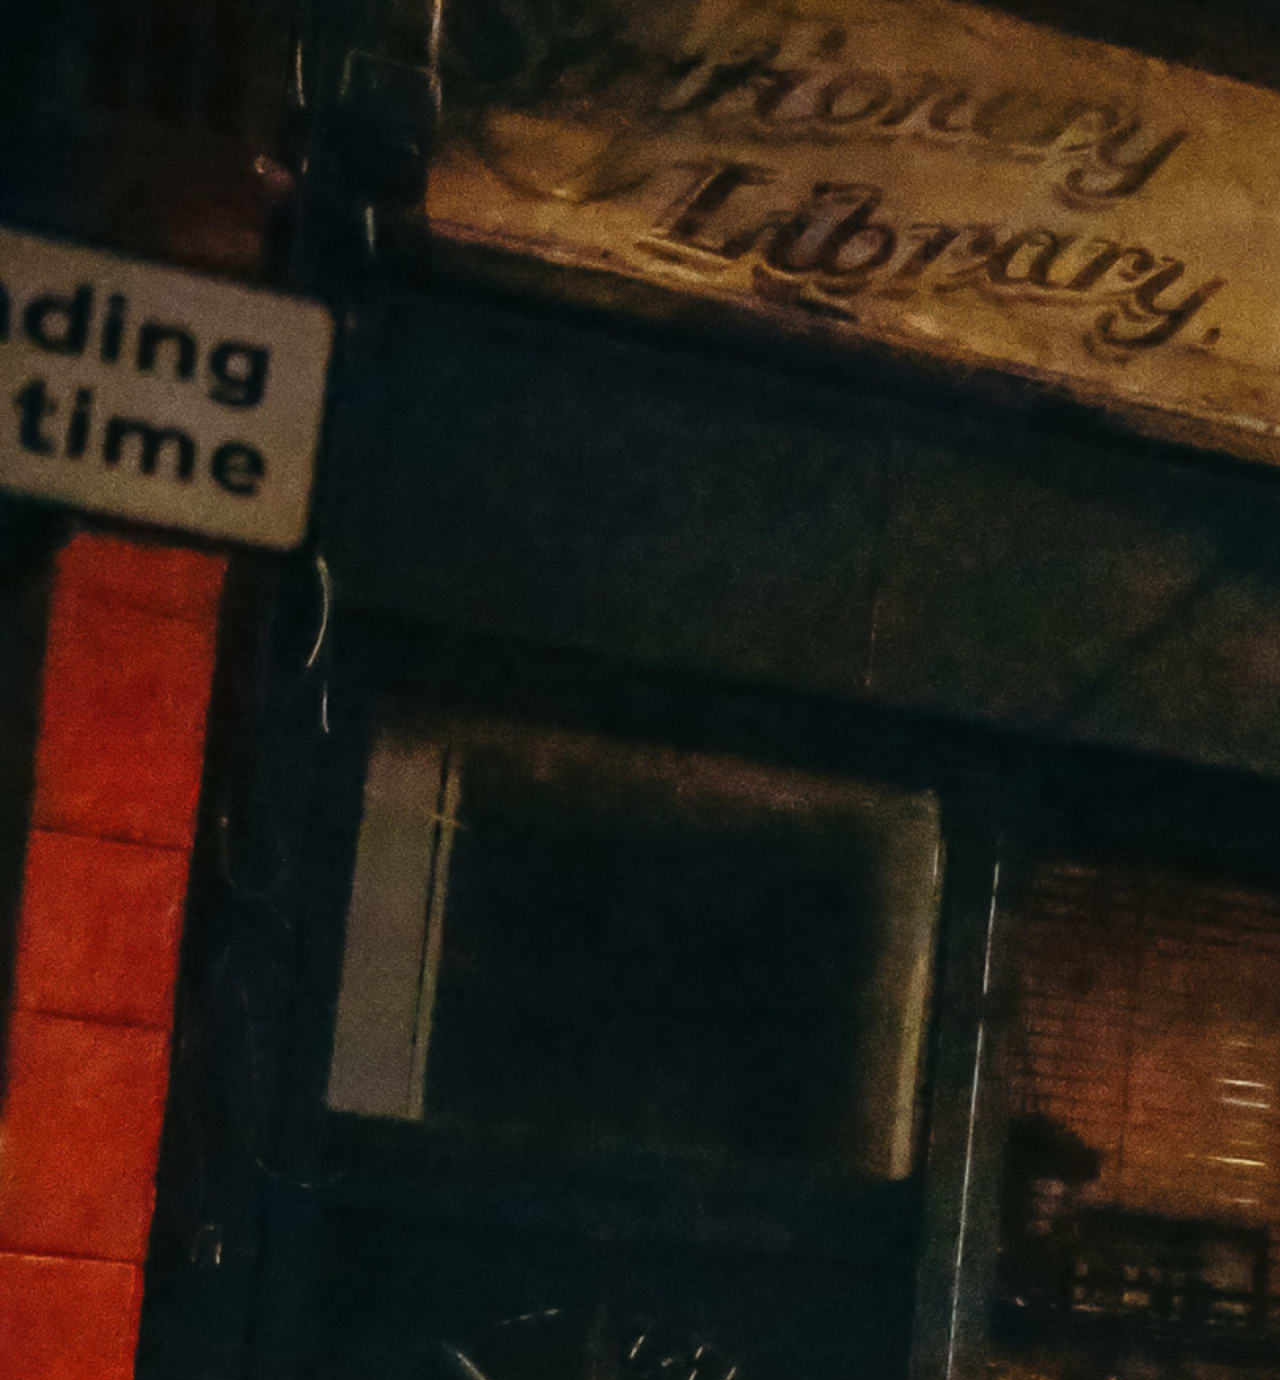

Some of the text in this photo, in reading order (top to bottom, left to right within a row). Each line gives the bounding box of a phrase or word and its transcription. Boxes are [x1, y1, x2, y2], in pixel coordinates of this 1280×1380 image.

[652, 28, 1190, 208] tionery
[0, 280, 271, 408] ding
[14, 378, 266, 497] time
